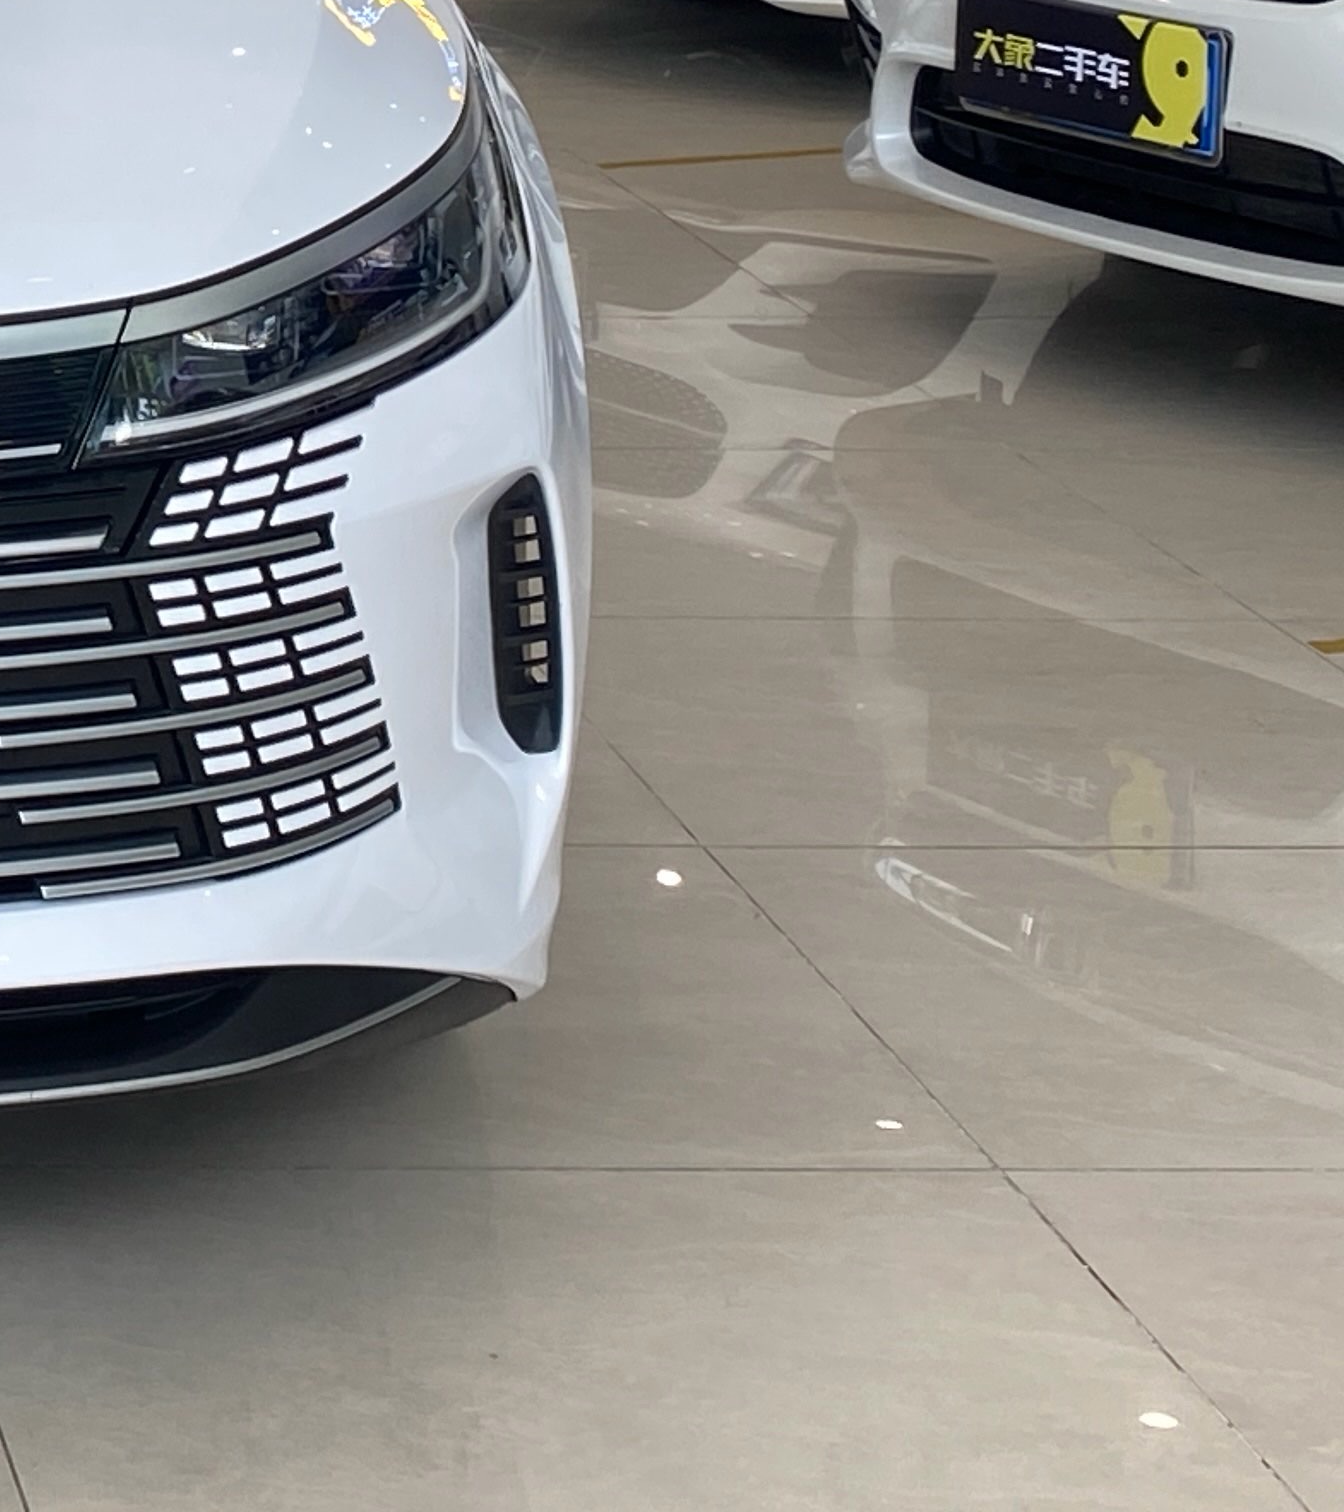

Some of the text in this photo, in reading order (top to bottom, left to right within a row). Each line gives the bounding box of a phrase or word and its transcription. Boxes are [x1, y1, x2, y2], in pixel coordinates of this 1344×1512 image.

[973, 28, 1130, 90] 大象二手车
